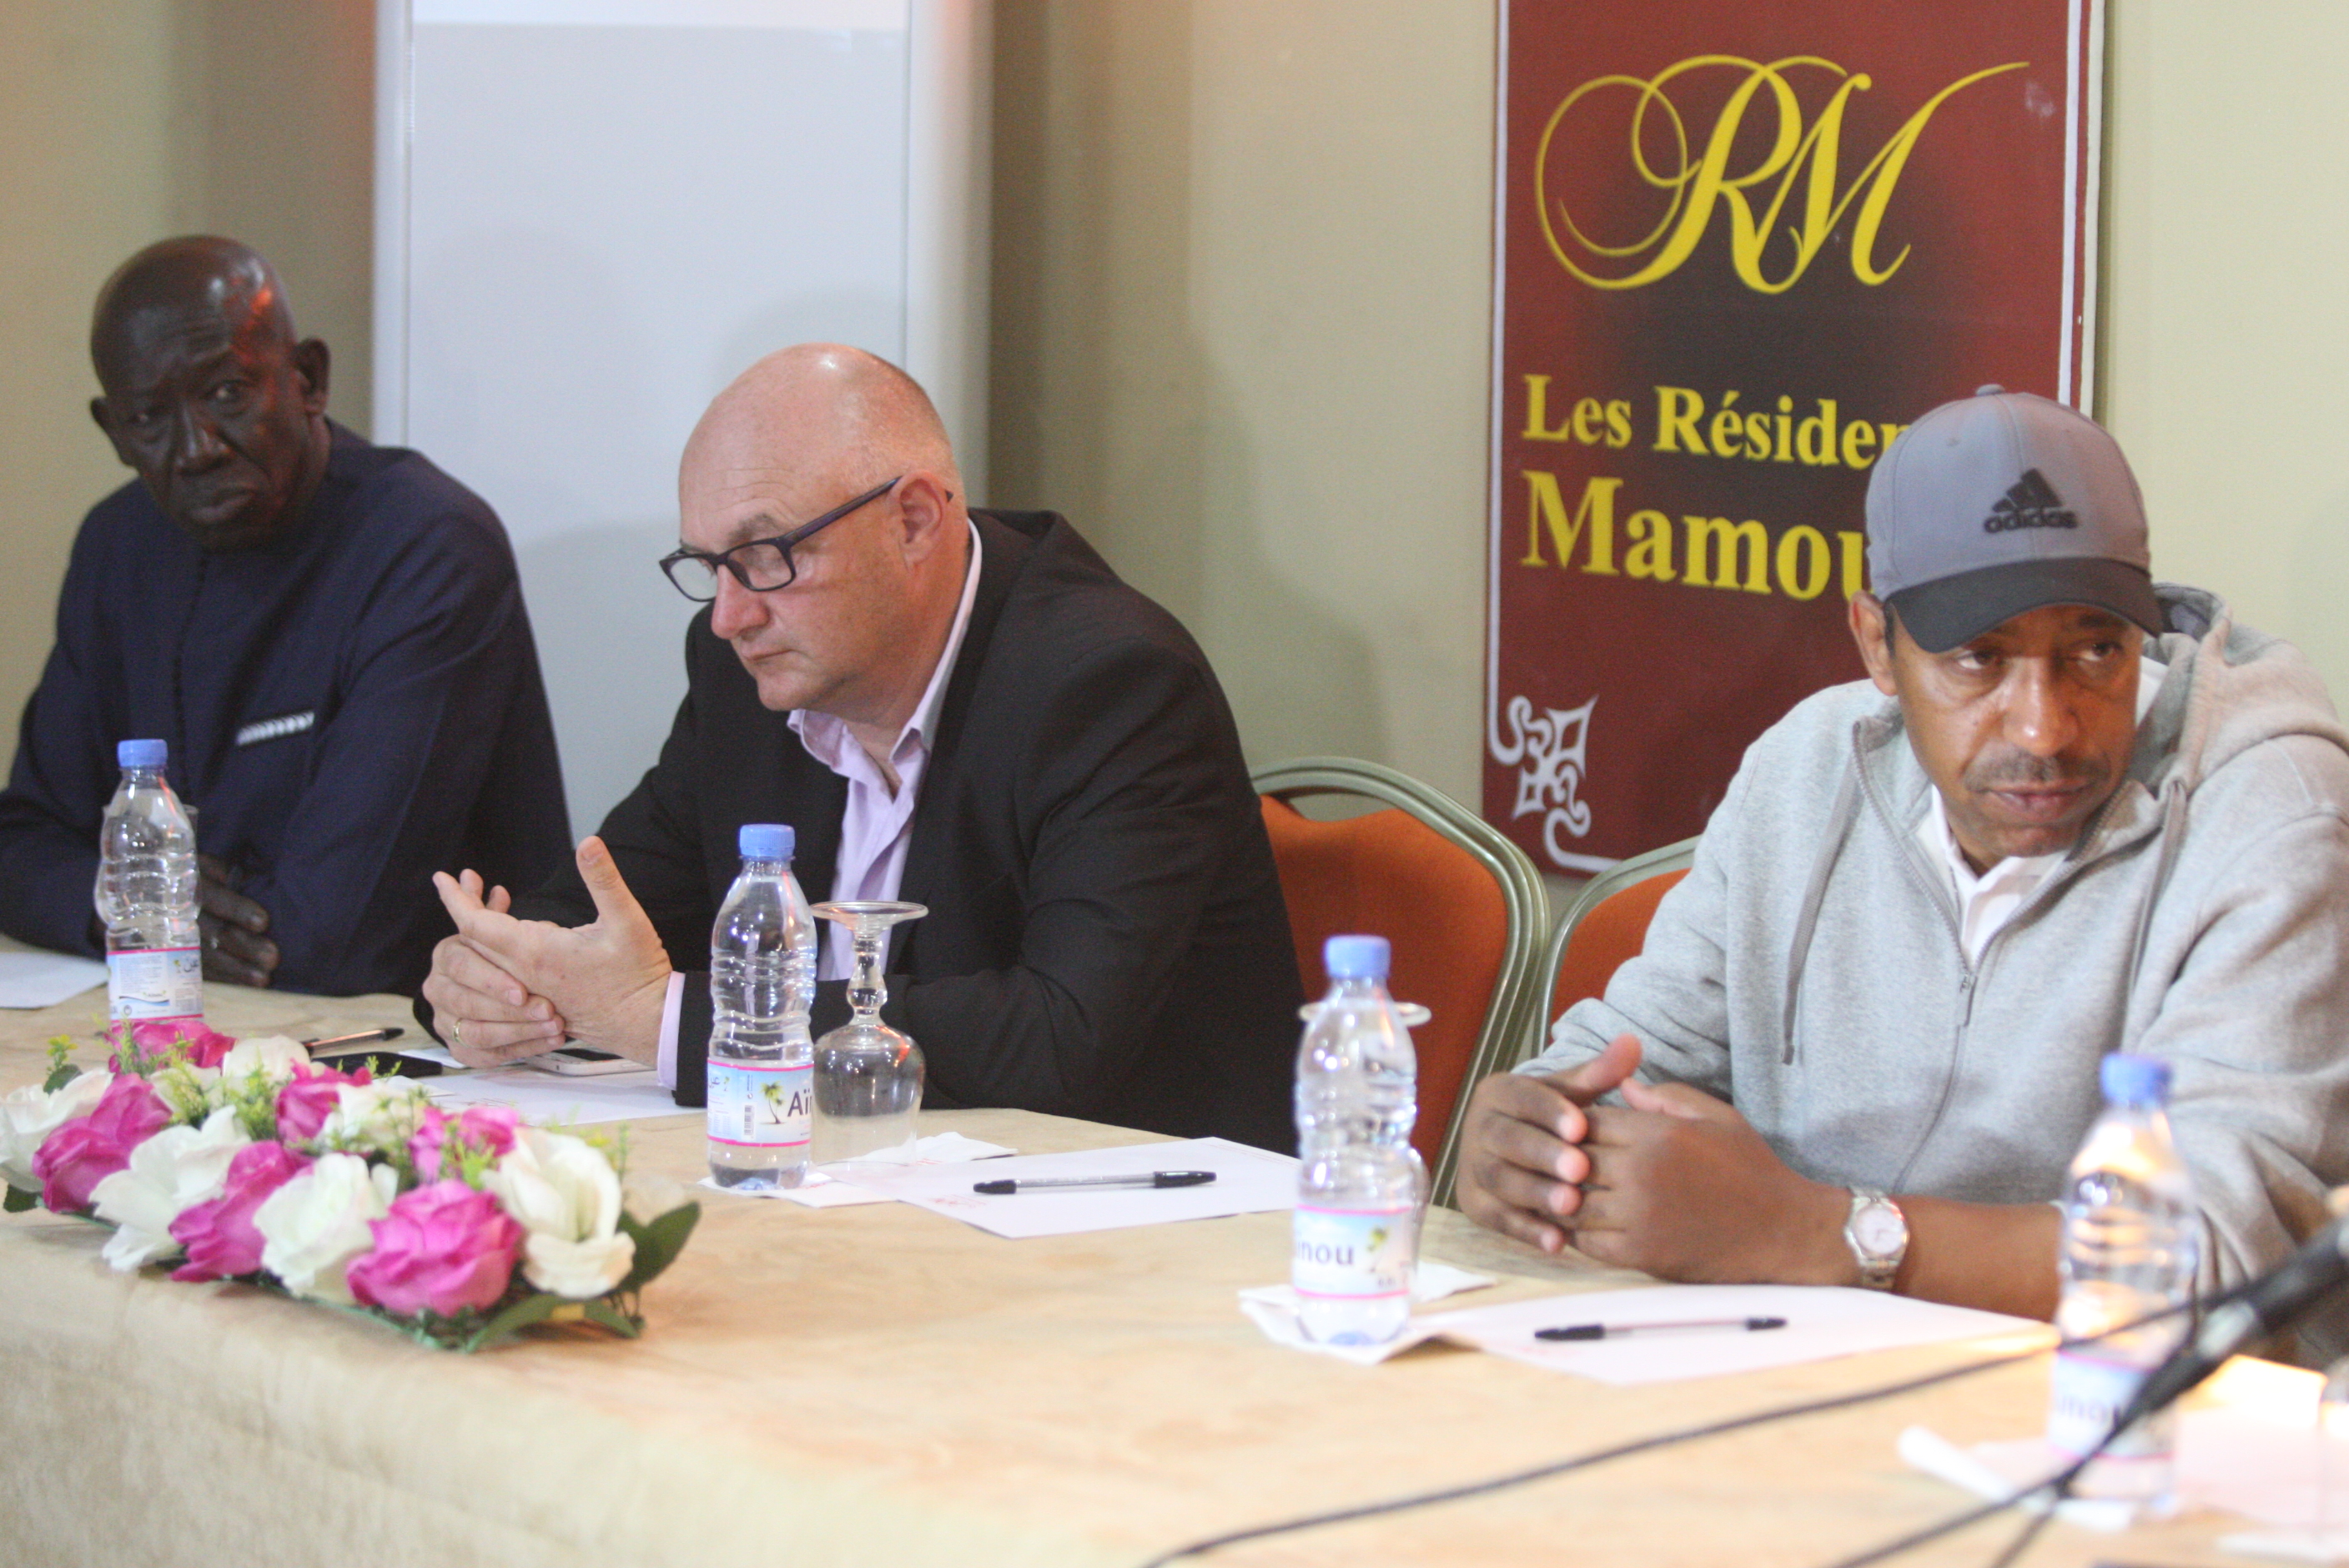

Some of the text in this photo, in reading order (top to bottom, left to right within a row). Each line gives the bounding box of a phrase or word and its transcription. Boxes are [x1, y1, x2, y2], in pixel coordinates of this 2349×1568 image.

[1535, 54, 2030, 295] RM
[1522, 374, 1632, 450] Les
[1983, 505, 2078, 534] adidas
